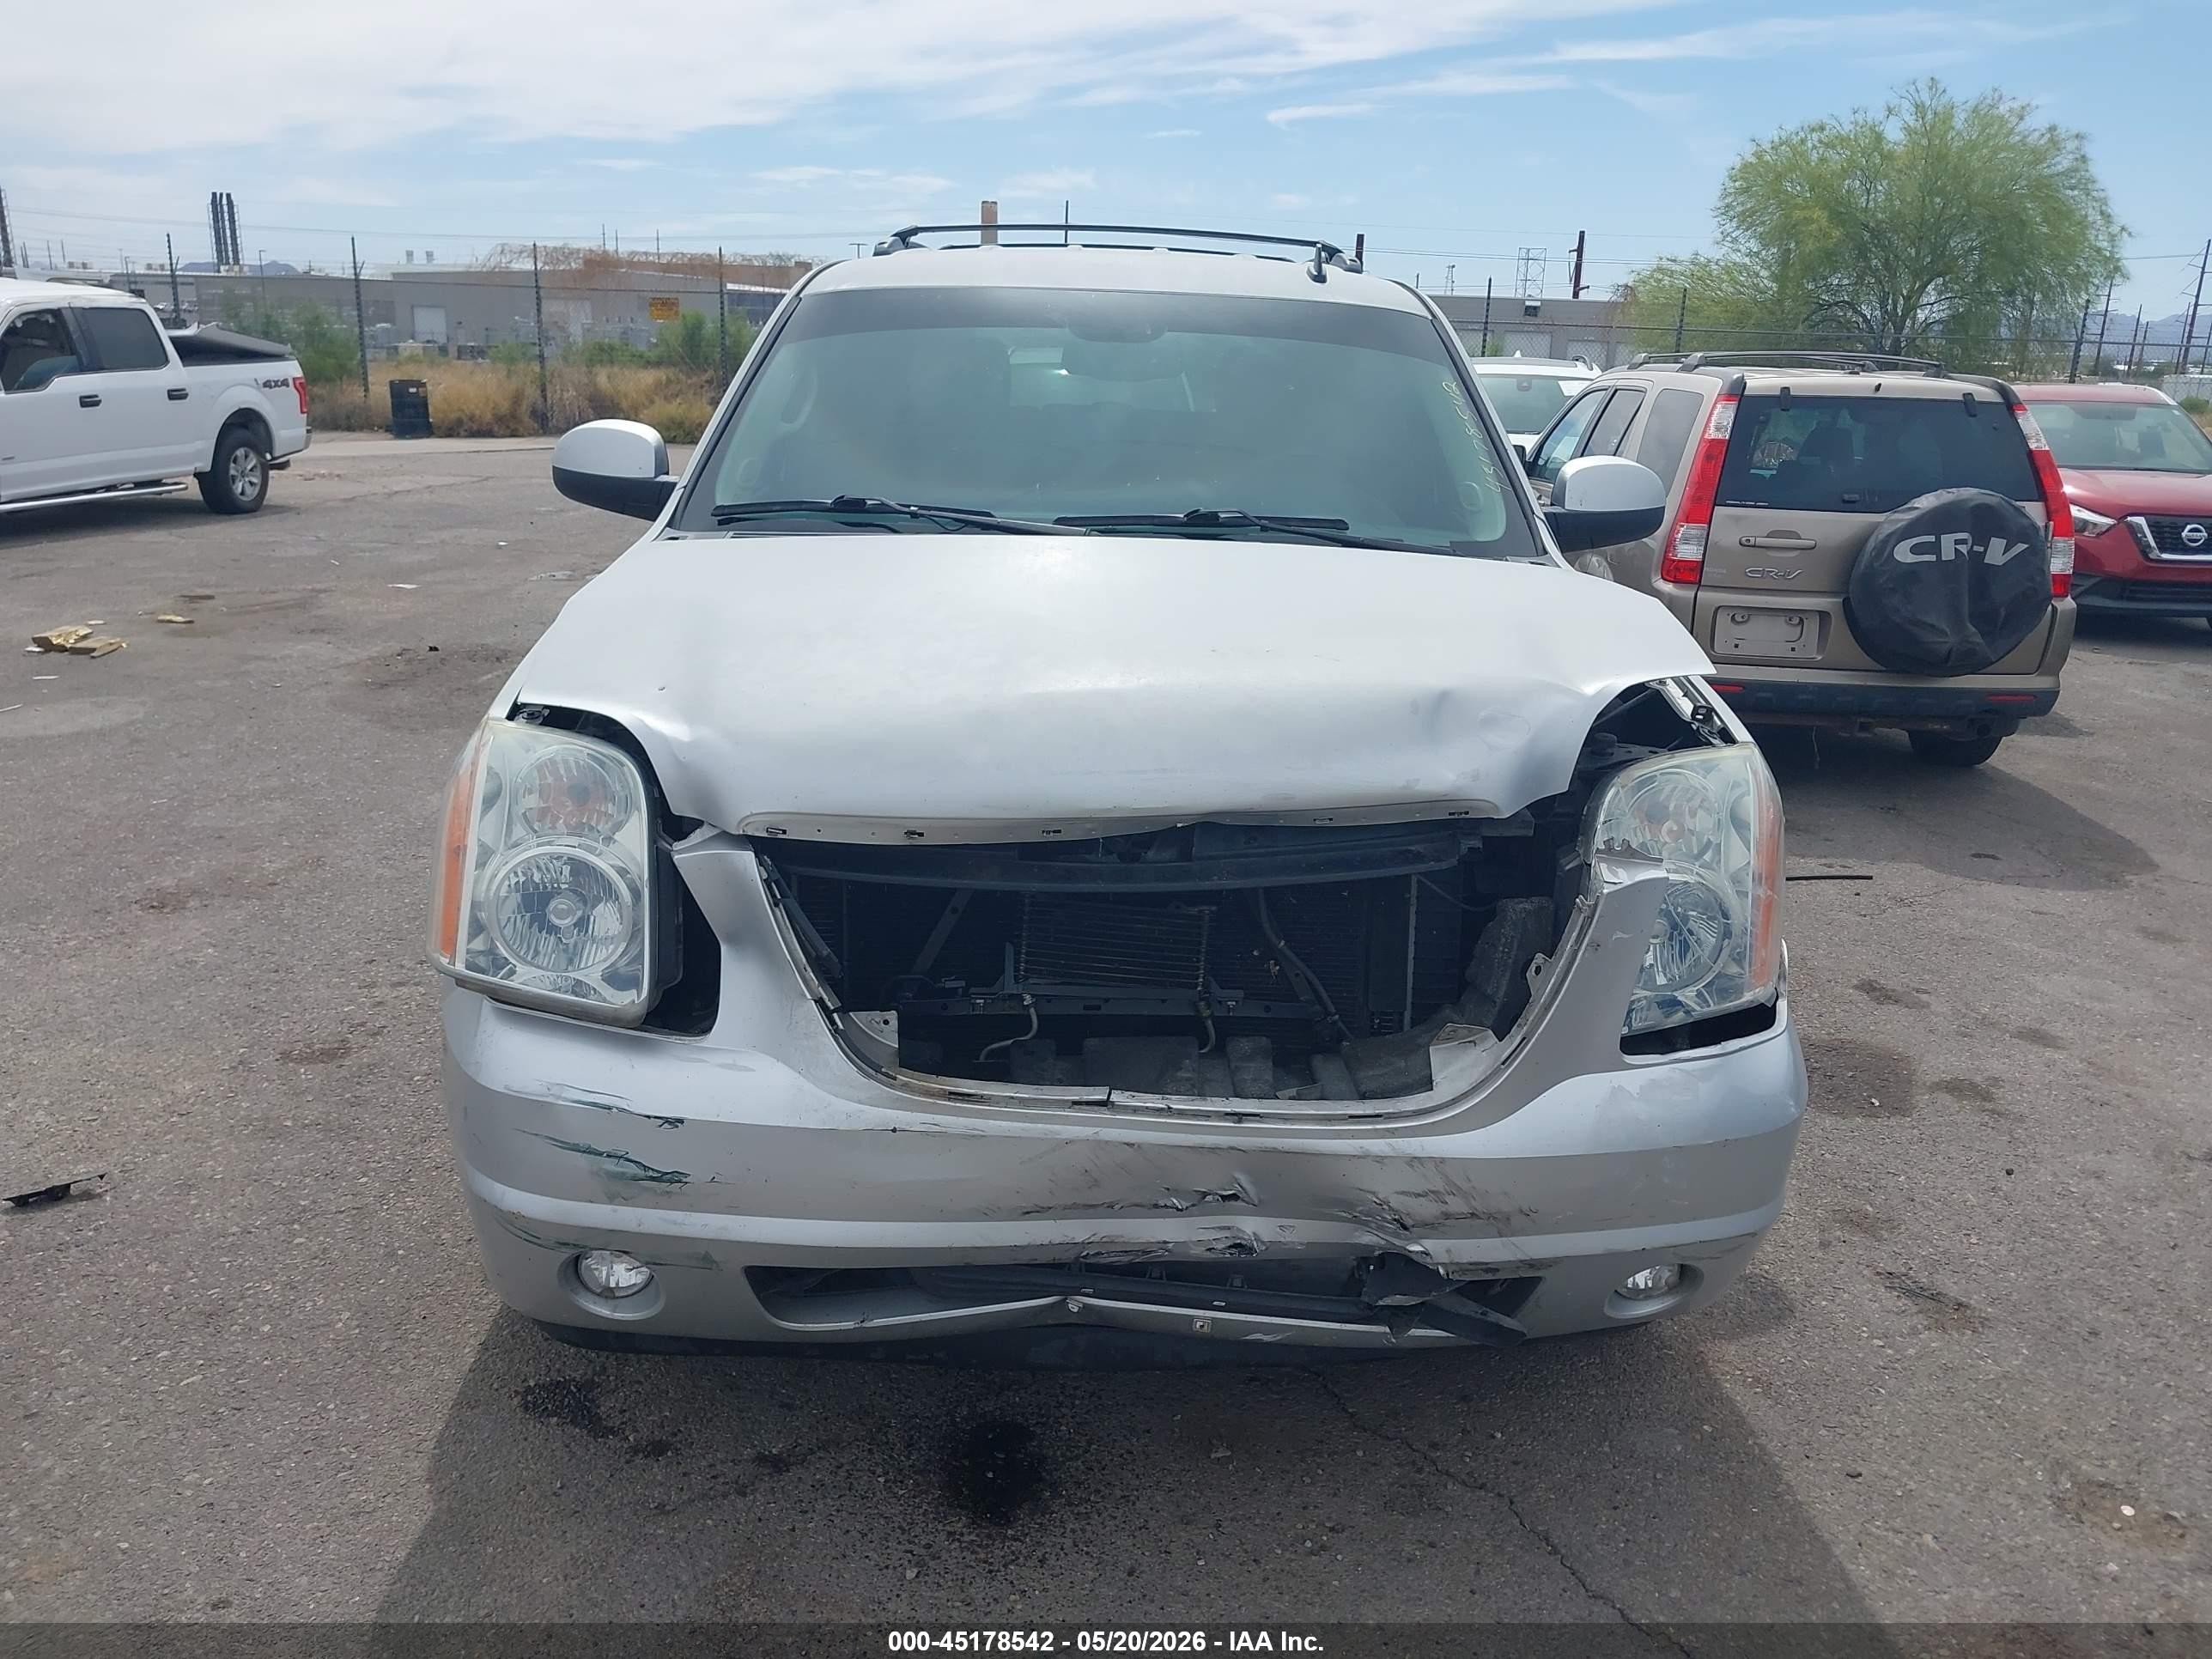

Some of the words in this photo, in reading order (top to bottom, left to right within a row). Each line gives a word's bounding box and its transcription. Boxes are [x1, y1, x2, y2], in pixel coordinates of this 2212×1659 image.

[1443, 381, 1512, 493] 45178542
[1893, 532, 2029, 566] CR-V
[1745, 567, 1803, 580] CR-V
